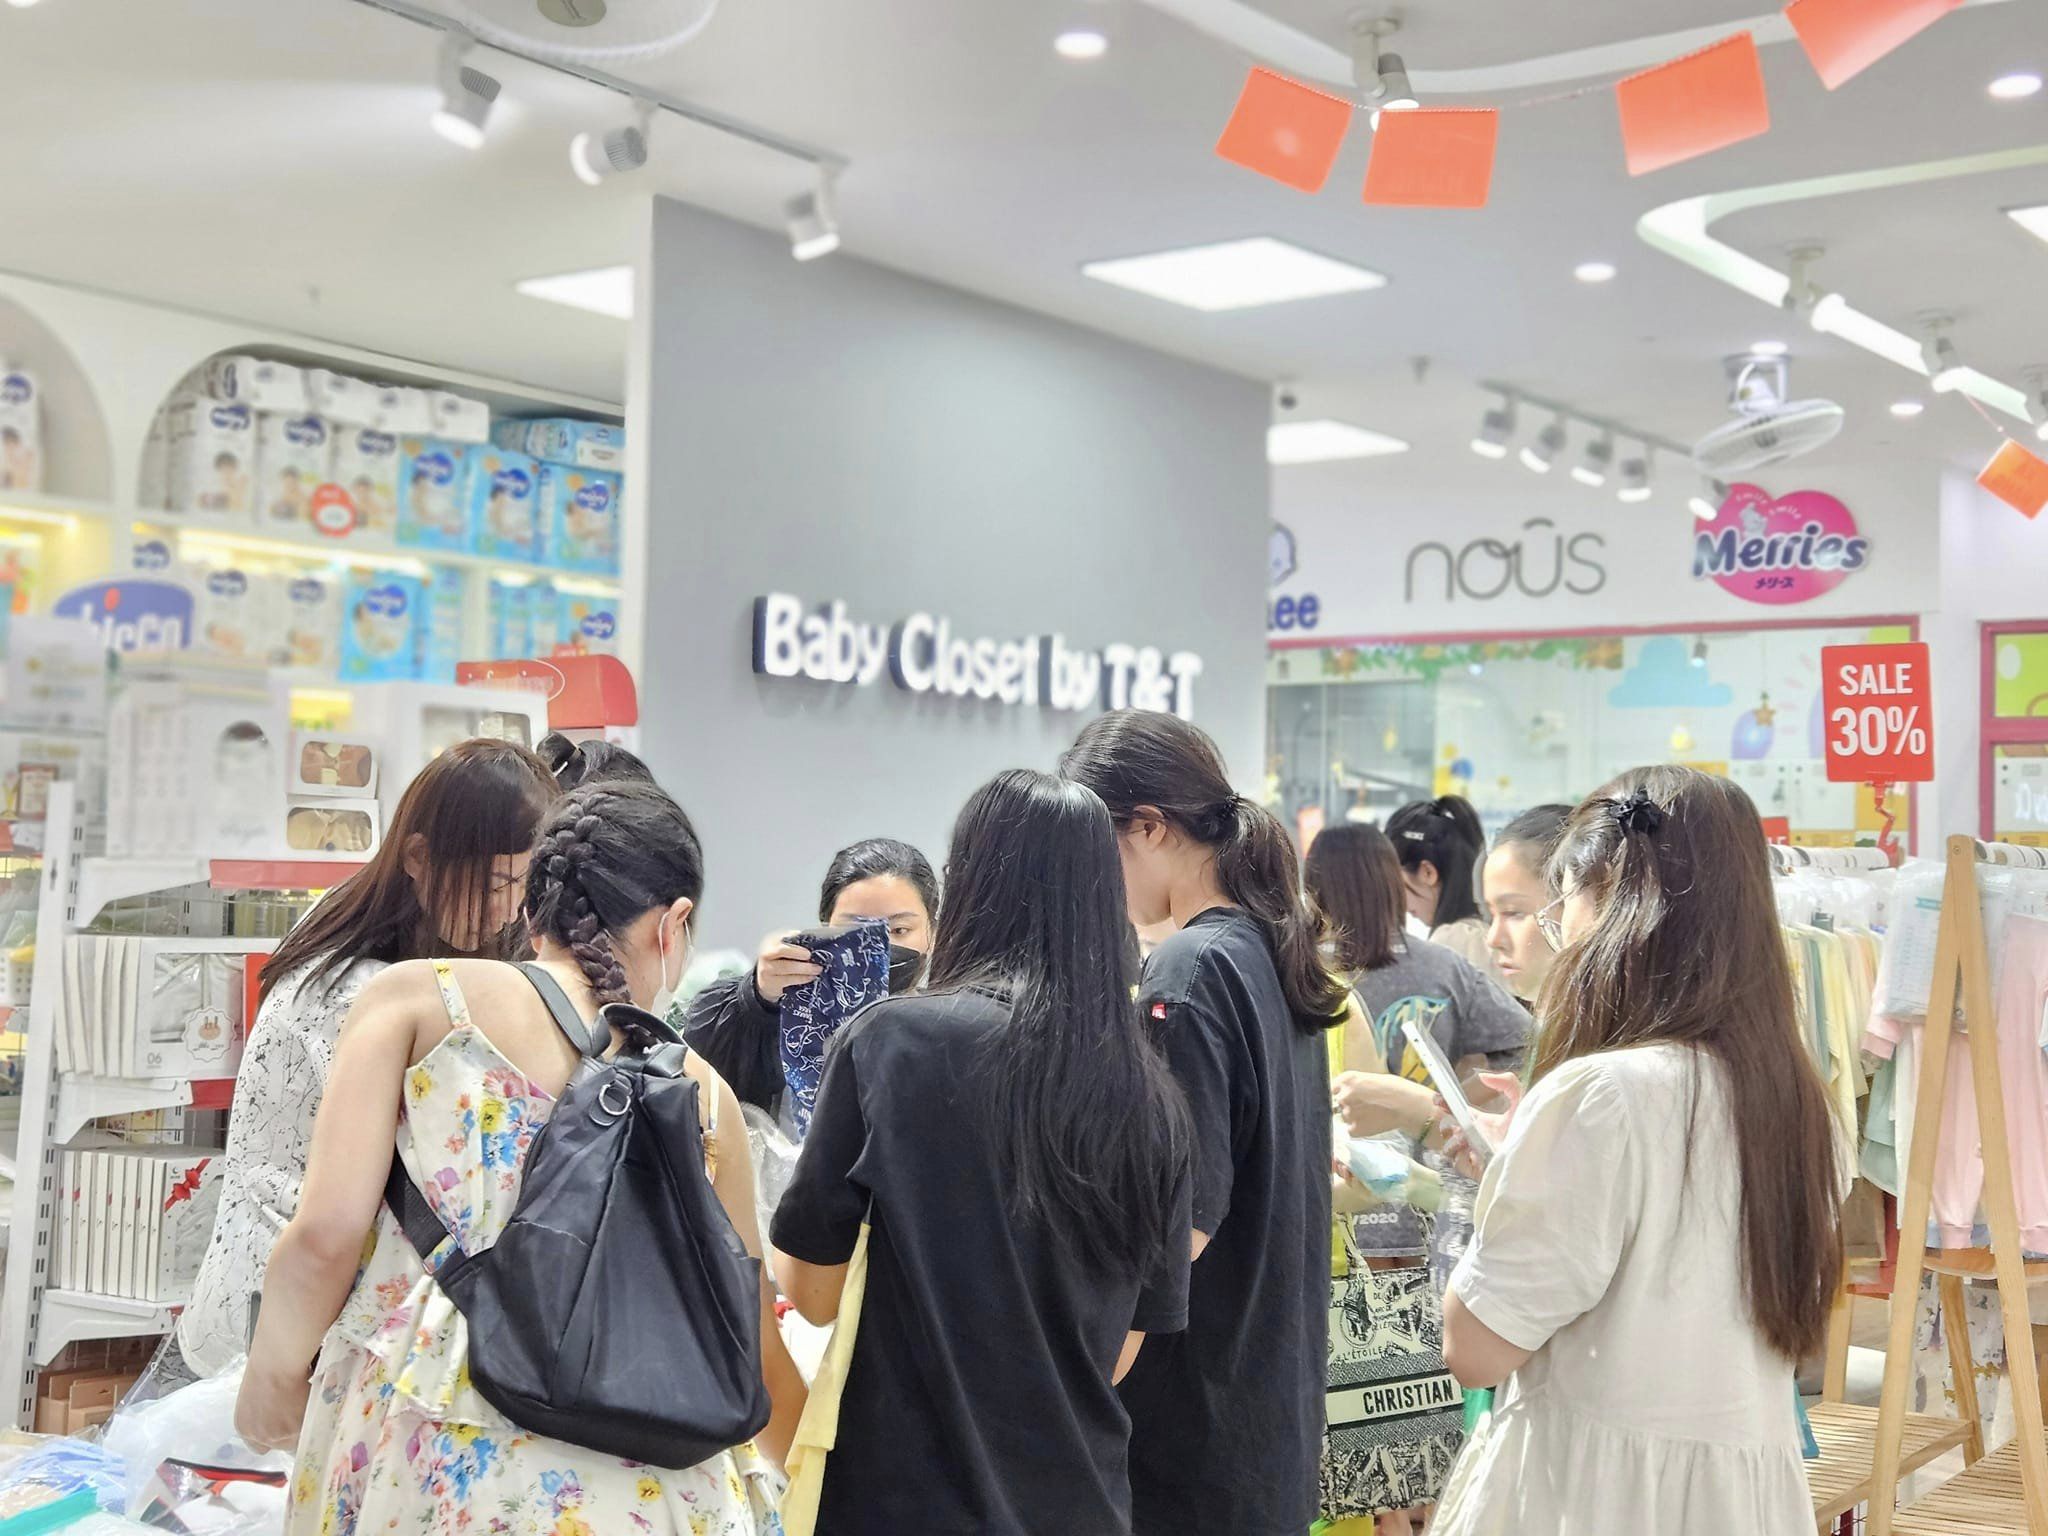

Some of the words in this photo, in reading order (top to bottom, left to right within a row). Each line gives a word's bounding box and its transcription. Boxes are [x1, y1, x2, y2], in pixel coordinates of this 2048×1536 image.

[1692, 523, 1869, 577] Merries
[1267, 593, 1320, 630] ee
[757, 592, 888, 686] Baby
[896, 612, 1042, 706] Closet
[1048, 634, 1101, 711] by
[1103, 643, 1204, 722] T&T
[1839, 662, 1913, 695] SALE
[1831, 705, 1926, 757] 30%
[1363, 1379, 1454, 1415] CHRISTIAN
